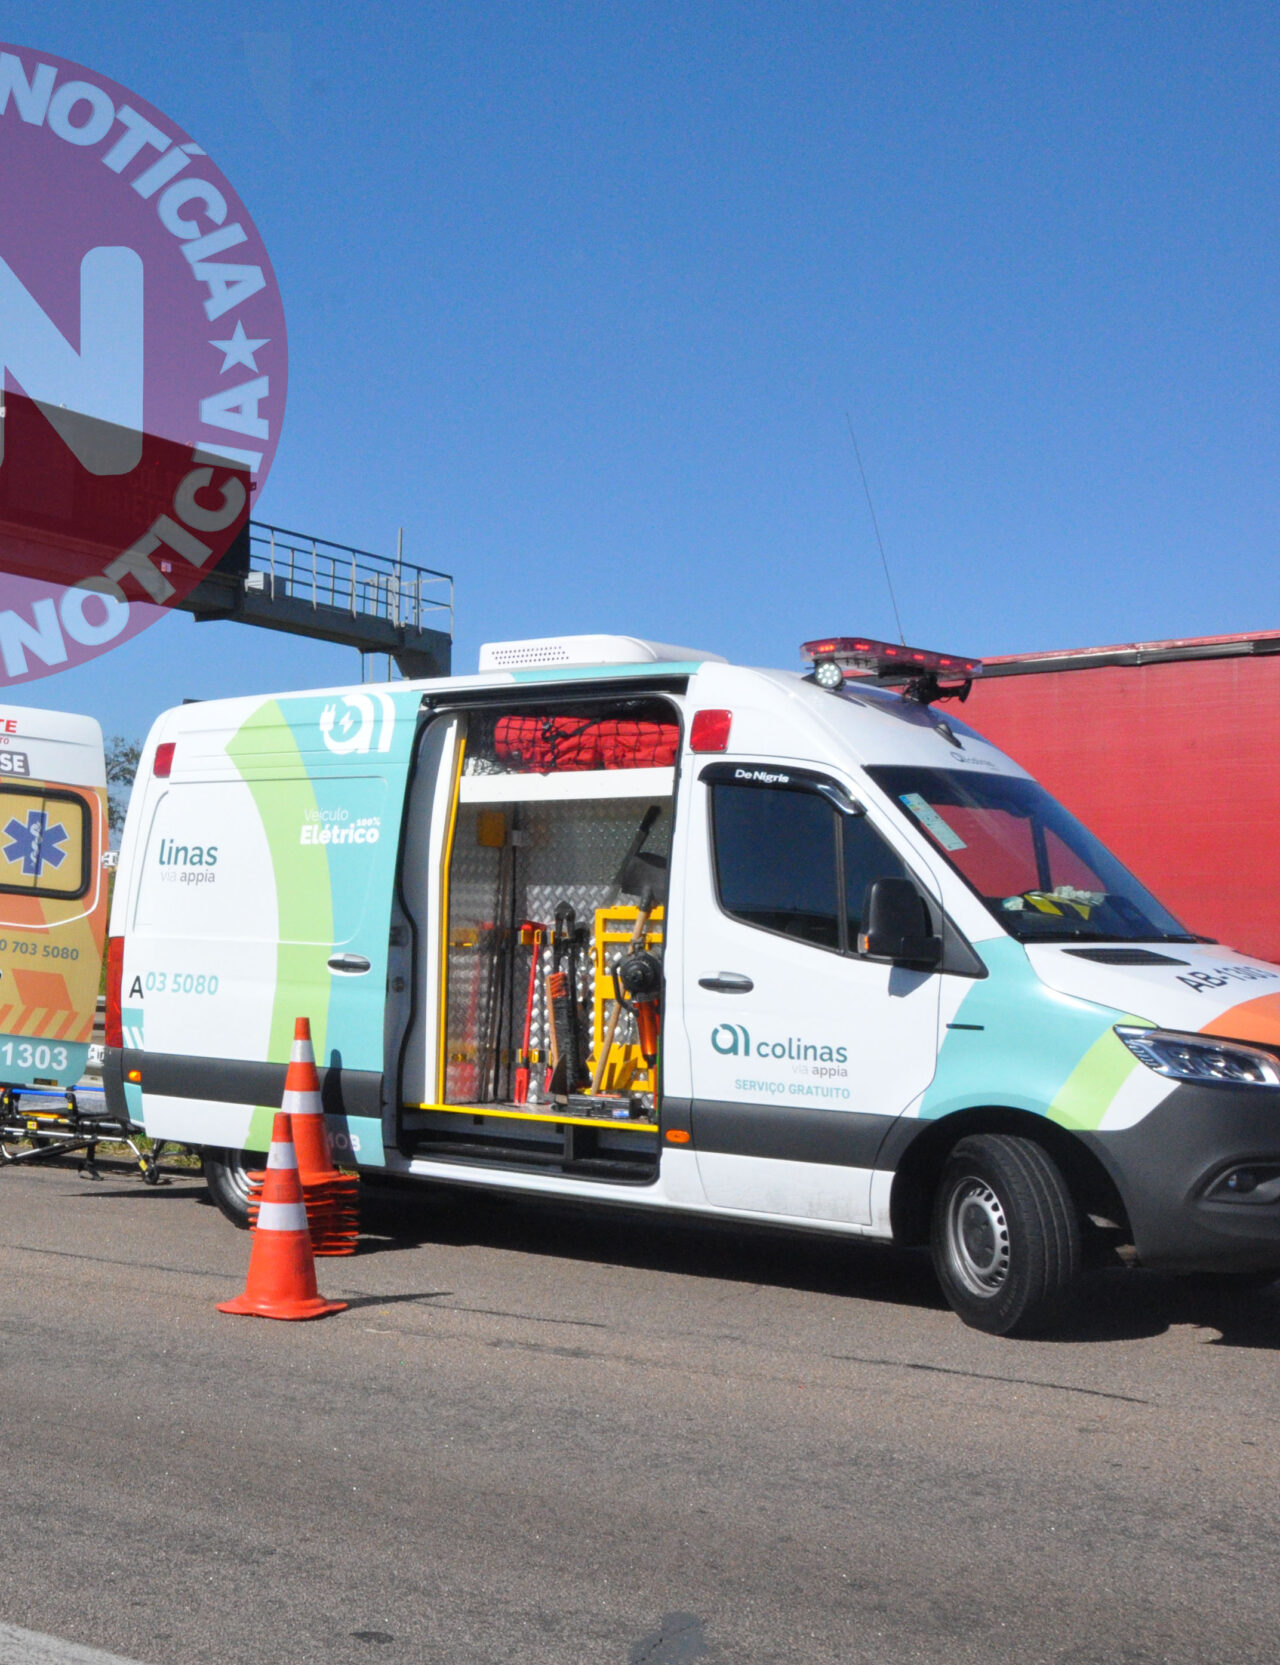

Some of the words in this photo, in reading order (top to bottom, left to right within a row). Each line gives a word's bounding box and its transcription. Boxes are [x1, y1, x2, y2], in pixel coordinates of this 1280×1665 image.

[734, 769, 753, 779] De
[753, 771, 790, 783] Nigris
[304, 808, 349, 821] Veículo
[356, 817, 381, 827] 100%
[300, 824, 380, 845] Elétrico
[159, 839, 218, 866] linas
[161, 871, 177, 882] via
[180, 869, 216, 886] appia
[12, 941, 38, 955] 703
[42, 946, 80, 960] 5080
[146, 971, 167, 992] 03
[171, 973, 219, 995] 5080
[756, 1037, 848, 1063] colinas
[811, 1065, 848, 1079] appia
[734, 1079, 785, 1095] SERVIÇO
[788, 1083, 850, 1099] GRATUITO
